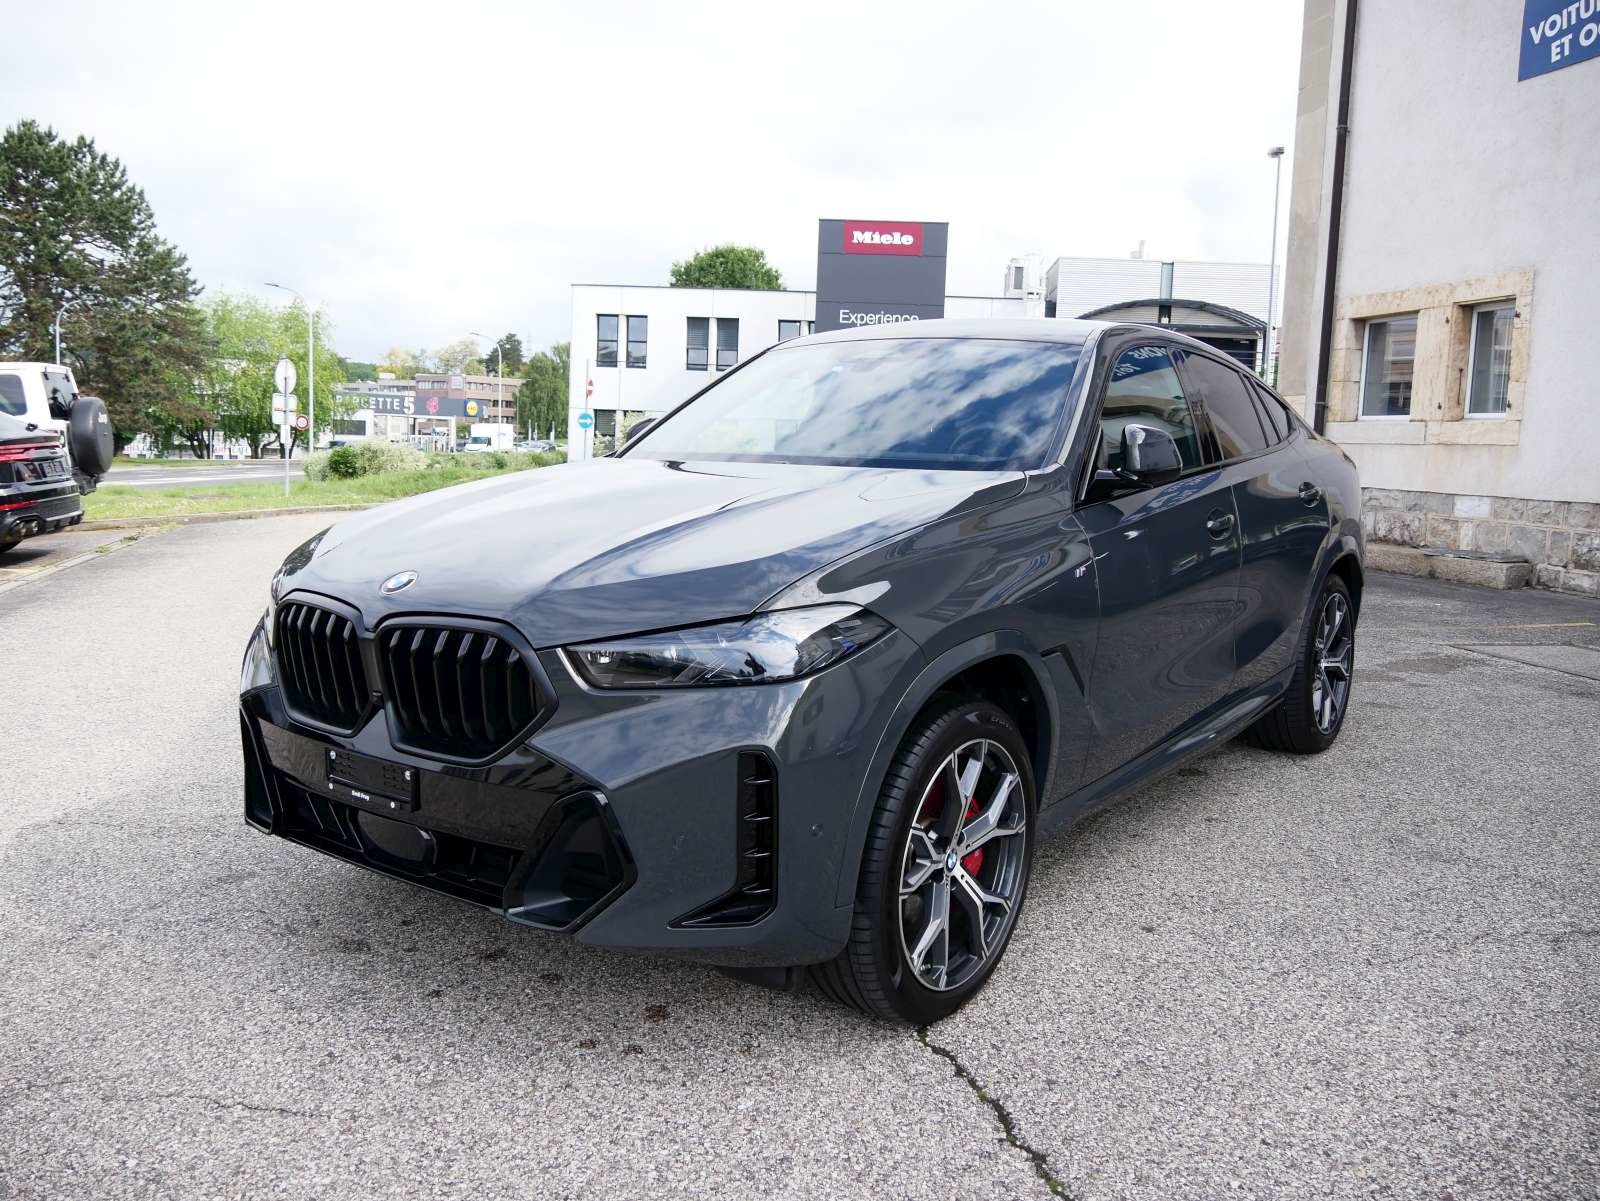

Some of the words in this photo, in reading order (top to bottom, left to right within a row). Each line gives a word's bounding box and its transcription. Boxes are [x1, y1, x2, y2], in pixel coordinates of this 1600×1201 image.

[1529, 0, 1600, 45] VOITU
[1550, 32, 1573, 64] ET
[1579, 22, 1600, 47] O
[851, 230, 914, 246] Miele
[402, 396, 416, 415] 5
